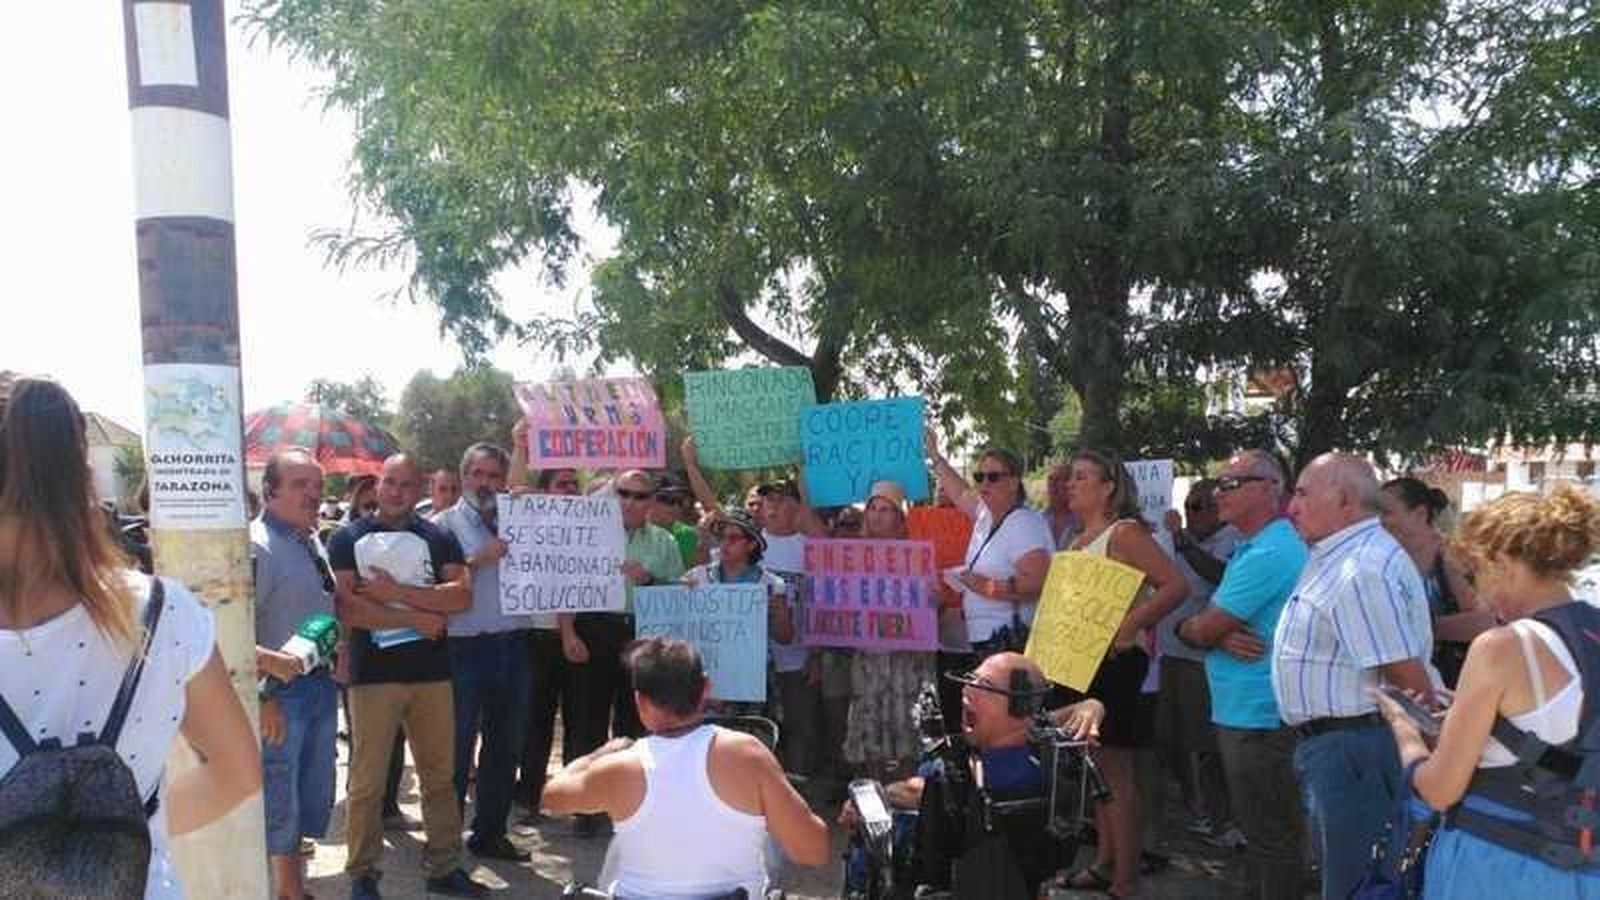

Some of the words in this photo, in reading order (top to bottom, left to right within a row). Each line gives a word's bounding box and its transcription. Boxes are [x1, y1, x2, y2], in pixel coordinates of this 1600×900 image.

[807, 403, 899, 436] COOPE
[154, 480, 233, 493] TARAZONA
[500, 496, 612, 518] TARAZONA
[506, 525, 527, 545] SE
[535, 525, 599, 547] SIENTE
